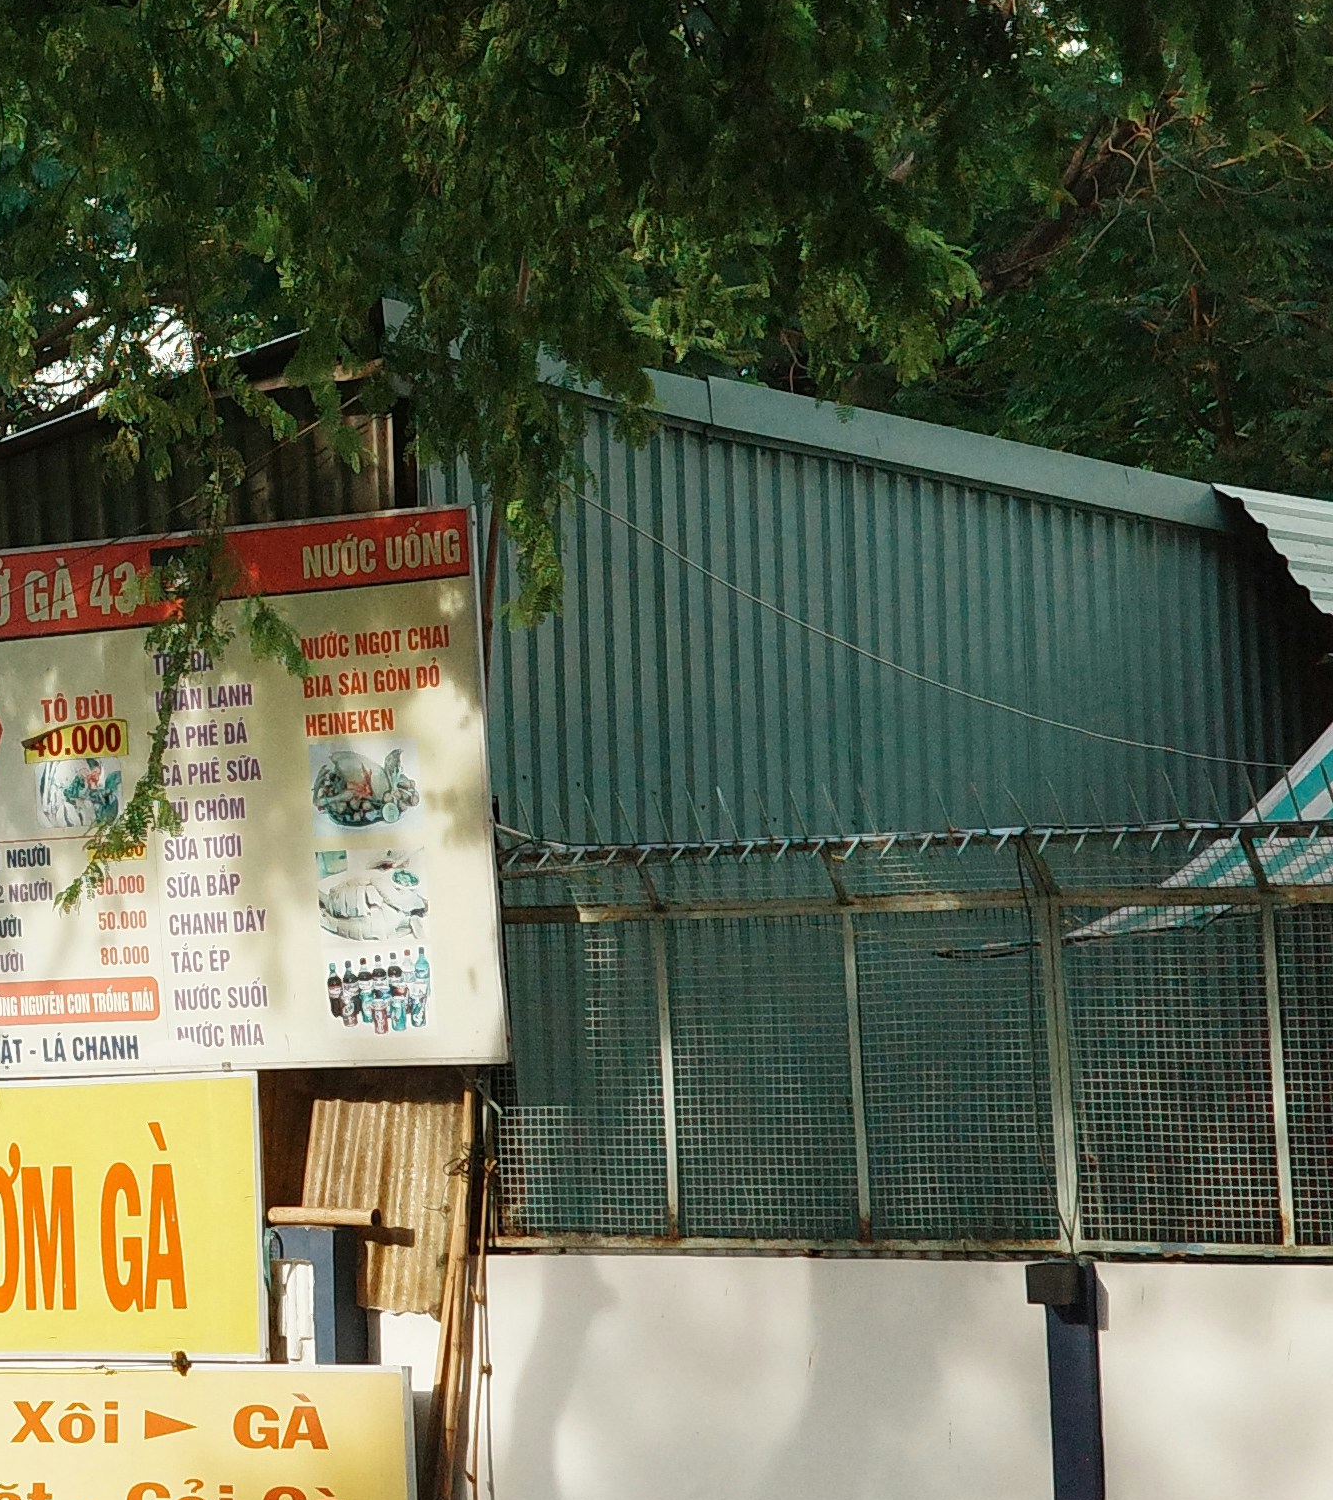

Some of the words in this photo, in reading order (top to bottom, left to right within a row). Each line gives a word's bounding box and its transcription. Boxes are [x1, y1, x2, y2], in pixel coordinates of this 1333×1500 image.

[302, 535, 376, 580] NƯỚC
[385, 521, 461, 571] UỐNG
[24, 556, 78, 622] GÀ
[90, 562, 137, 615] 43
[300, 632, 349, 660] NƯỚC
[355, 629, 401, 660] NGỌT
[407, 625, 450, 650] CHAI
[304, 673, 332, 698] BIA
[339, 665, 368, 696] SÀI
[374, 664, 411, 693] GÒN
[416, 656, 440, 689] ĐỎ
[41, 693, 67, 723] TÔ
[75, 690, 113, 720] ĐÙI
[208, 684, 252, 712] LẠNH
[186, 719, 219, 747] PHÊ
[224, 716, 248, 744] ĐÁ
[305, 708, 394, 737] HEINEKEN
[29, 722, 121, 757] 40.000
[161, 760, 183, 787] CÀ
[188, 757, 221, 785] PHÊ
[226, 754, 262, 782] SỮA
[194, 793, 245, 821] CHÔM
[6, 842, 51, 868] NGƯỜI
[164, 832, 198, 861] SỮA
[203, 832, 243, 860] TƯƠI
[9, 876, 53, 903] NGƯỜI
[166, 870, 201, 899] SỮA
[206, 865, 241, 897] BẮP
[98, 910, 147, 932] 50.000
[169, 910, 228, 936] CHANH
[234, 905, 267, 932] DÂY
[101, 946, 150, 967] 80.000
[171, 943, 204, 973] TẮC
[209, 944, 230, 971] ÉP
[66, 992, 91, 1015] CON
[132, 986, 155, 1012] MÁI
[174, 983, 221, 1010] NƯỚC
[227, 977, 268, 1009] SUỐI
[42, 1032, 68, 1063] LÁ
[72, 1034, 140, 1062] CHANH
[230, 1019, 265, 1047] MÍA
[100, 1121, 188, 1313] GÀ
[11, 1400, 119, 1444] Xôi
[232, 1392, 331, 1451] GÀ
